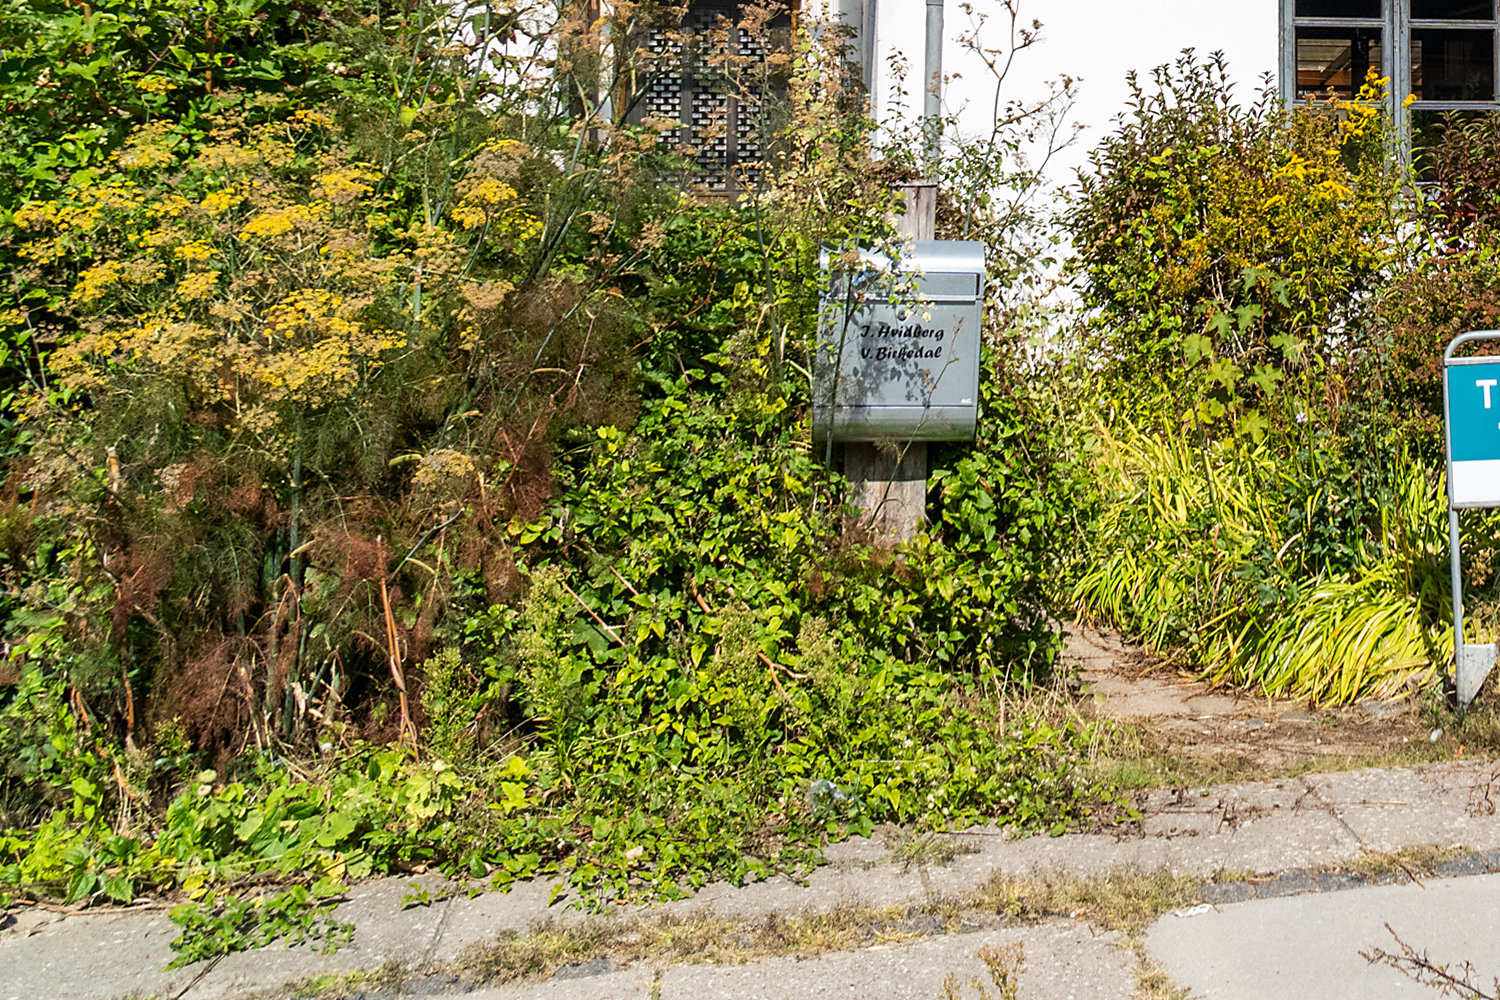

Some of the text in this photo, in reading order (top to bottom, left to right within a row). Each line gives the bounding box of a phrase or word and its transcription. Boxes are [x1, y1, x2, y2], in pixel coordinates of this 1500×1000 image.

[878, 325, 944, 341] Hvidberg
[861, 346, 942, 361] V. Birkedal
